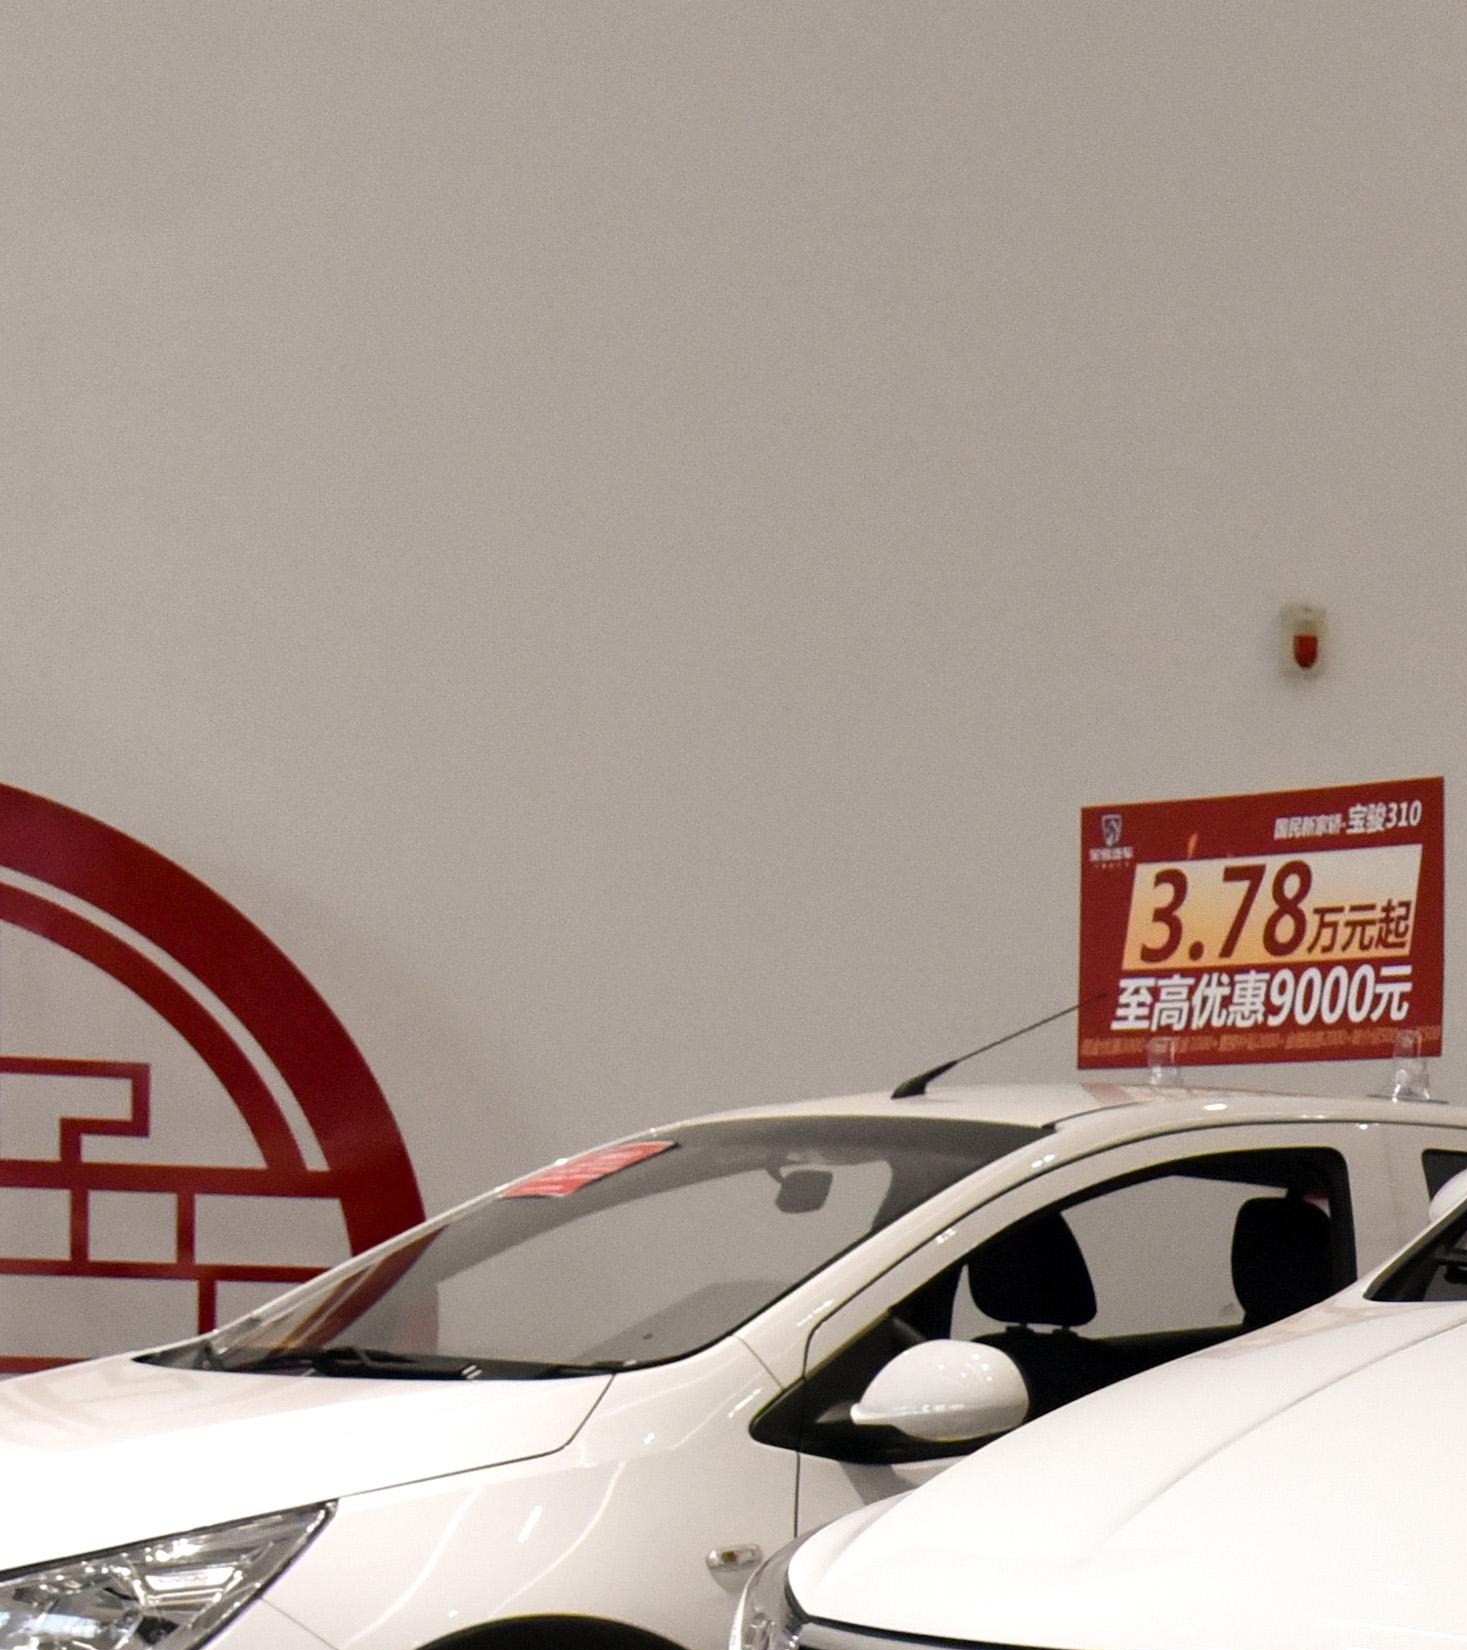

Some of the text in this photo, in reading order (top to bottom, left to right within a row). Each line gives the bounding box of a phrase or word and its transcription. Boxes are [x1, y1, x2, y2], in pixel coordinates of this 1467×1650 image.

[1111, 964, 1412, 1031] 至高优惠9000元
